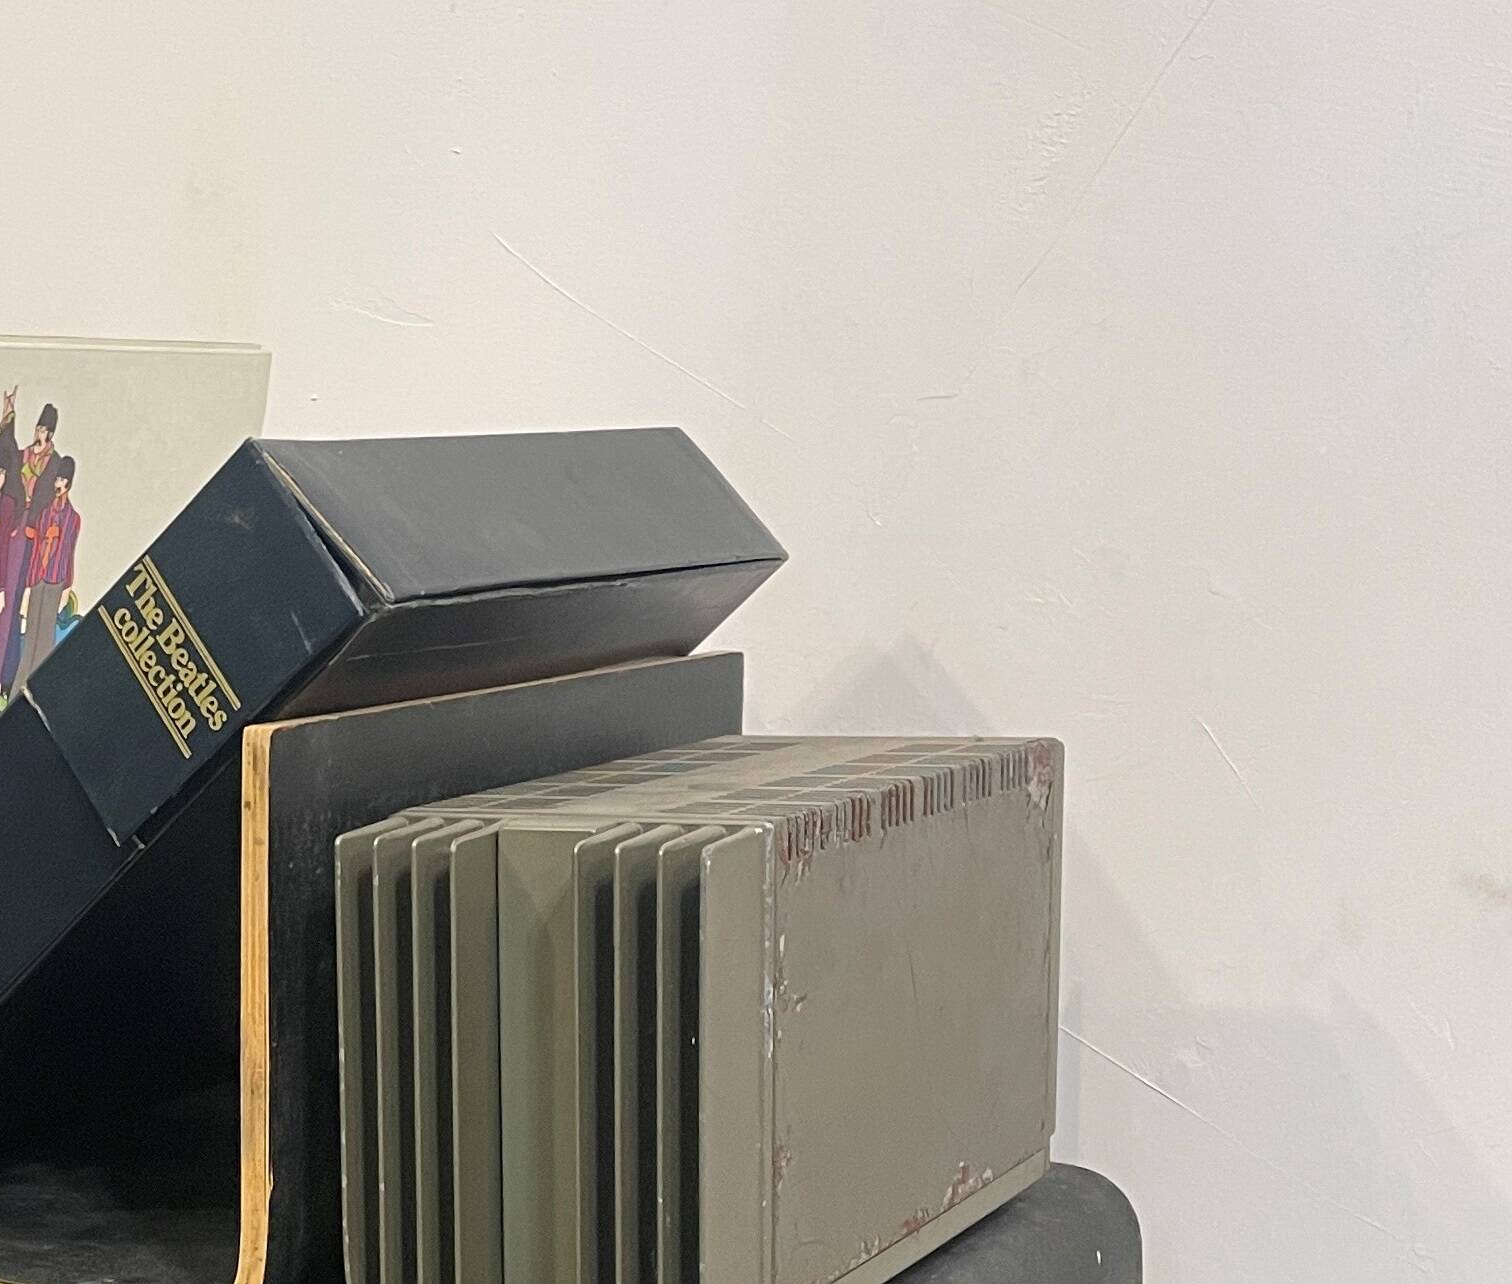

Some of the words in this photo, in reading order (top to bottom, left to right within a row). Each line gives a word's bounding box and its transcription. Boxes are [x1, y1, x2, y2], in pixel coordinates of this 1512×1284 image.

[113, 607, 197, 739] collection
[125, 562, 164, 630] The
[155, 618, 228, 732] Beatles
